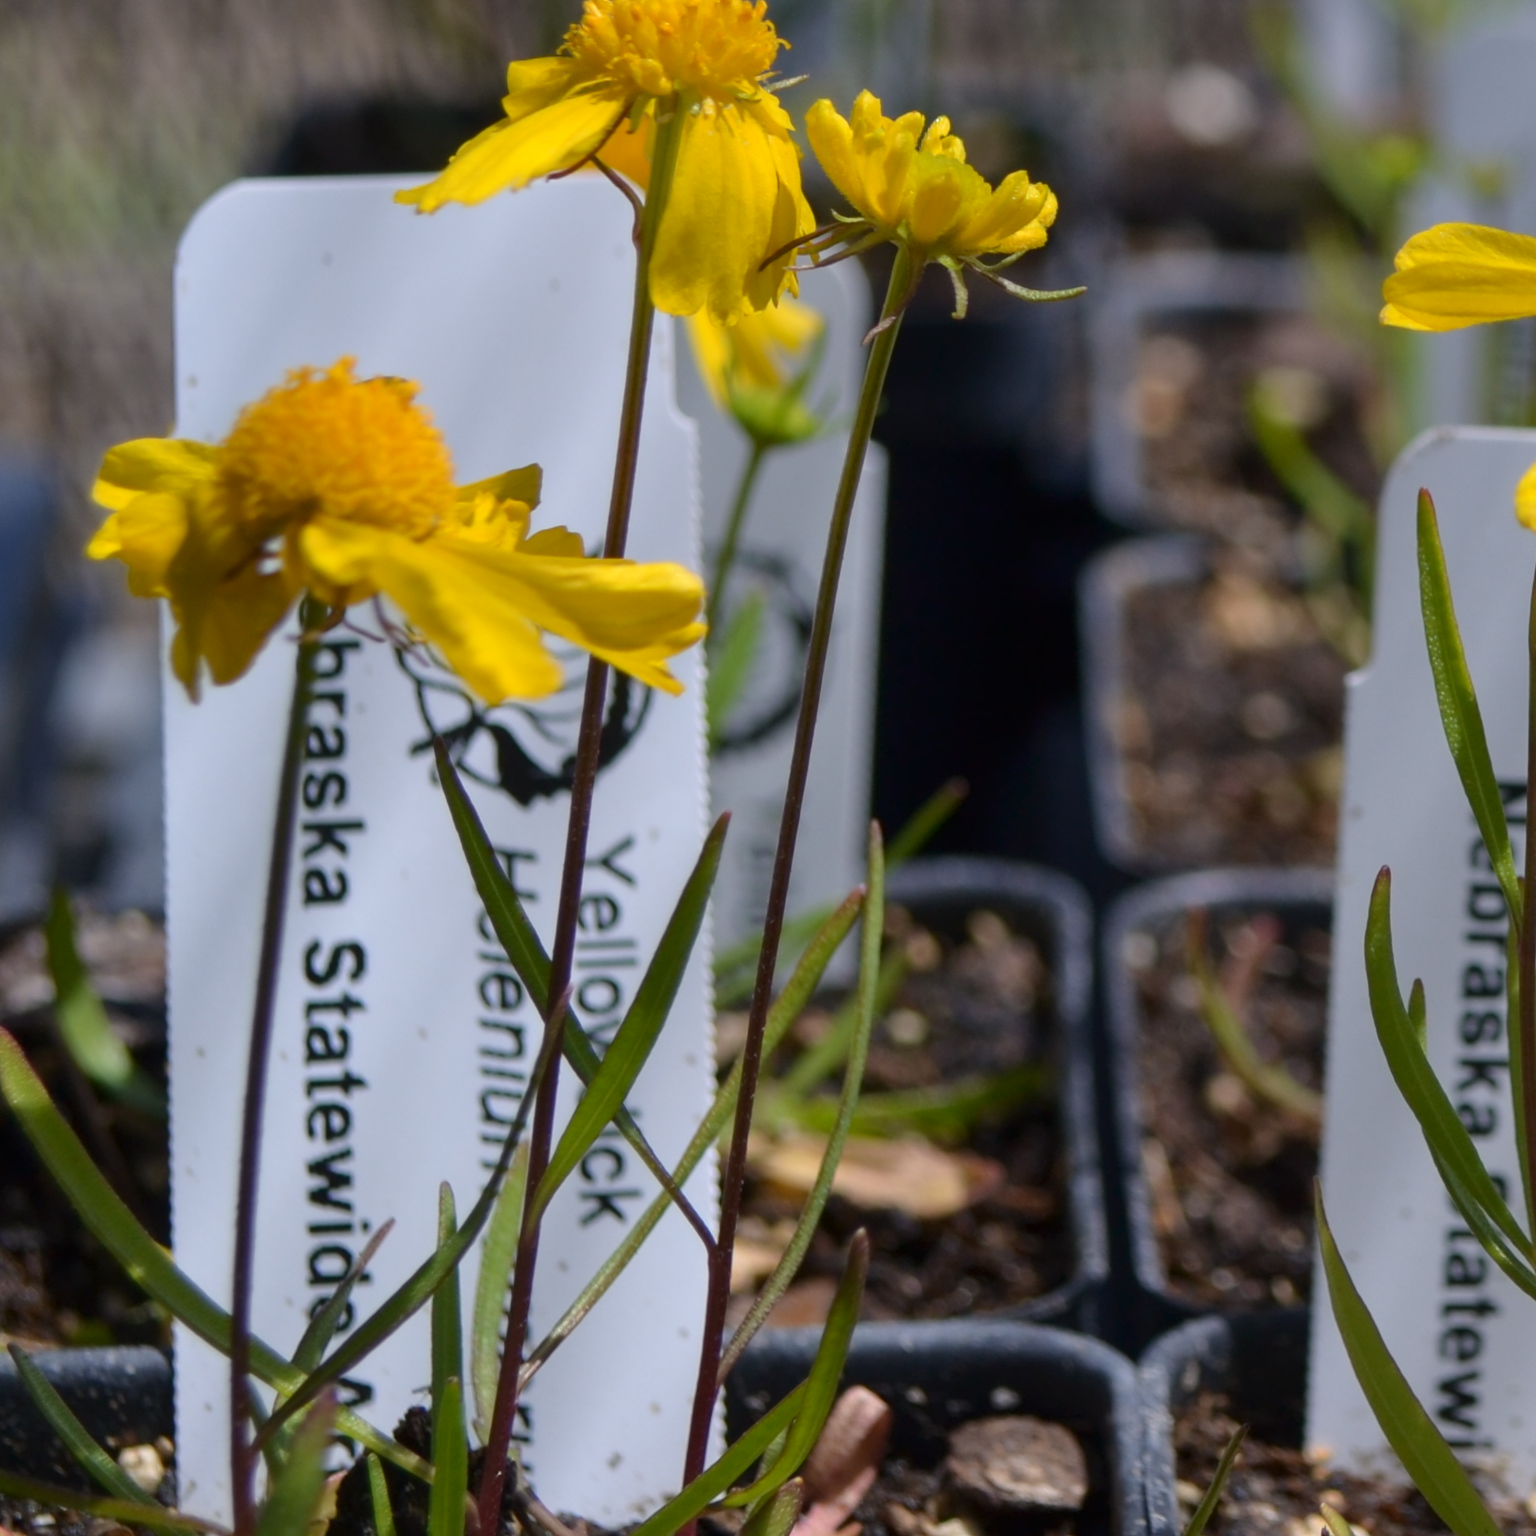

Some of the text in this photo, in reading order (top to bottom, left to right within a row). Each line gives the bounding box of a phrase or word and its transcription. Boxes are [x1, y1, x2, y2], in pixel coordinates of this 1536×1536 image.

[301, 638, 366, 906] braska
[303, 941, 366, 1335] Statewide
[577, 838, 643, 1226] Yellock
